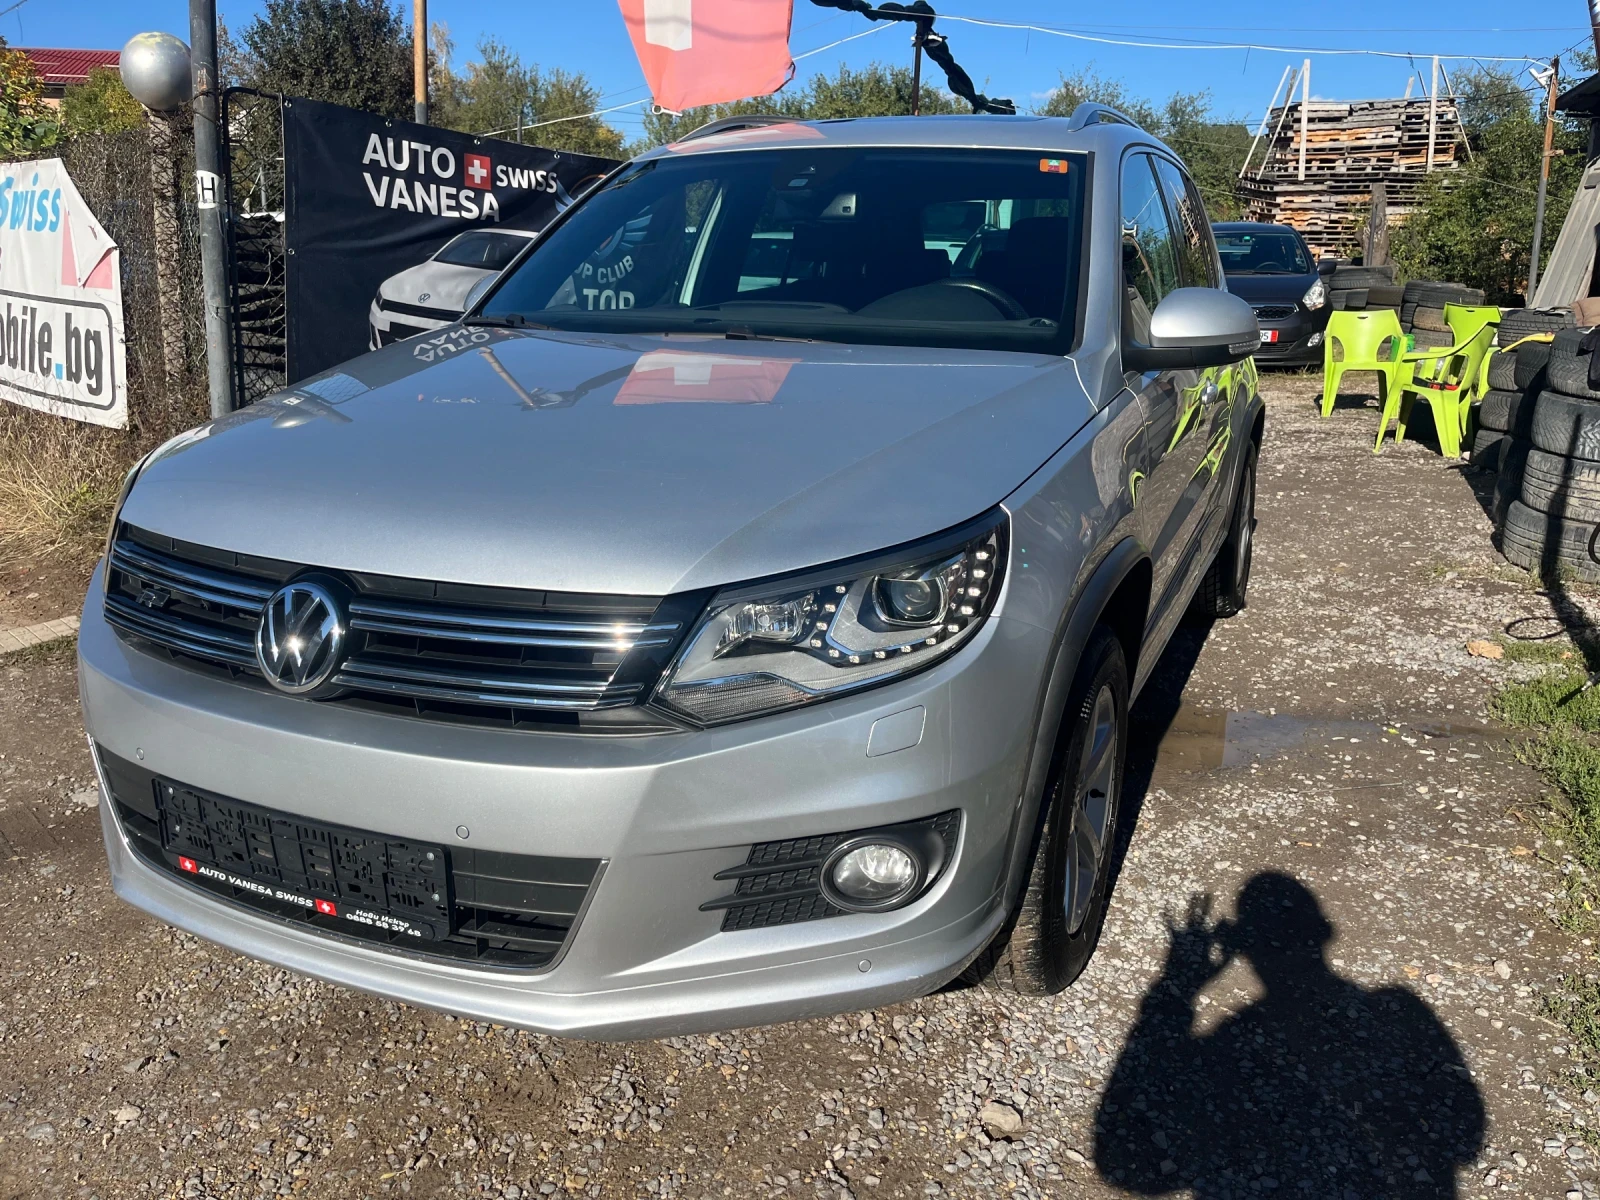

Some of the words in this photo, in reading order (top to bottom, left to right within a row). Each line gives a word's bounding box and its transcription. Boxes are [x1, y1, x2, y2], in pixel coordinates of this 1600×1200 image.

[362, 133, 456, 179] AUTO
[496, 165, 557, 193] SWISS
[198, 176, 215, 203] H
[362, 172, 500, 222] VANESA
[597, 255, 634, 284] CLUB
[199, 867, 226, 881] AUTO
[228, 875, 273, 896] VANESA
[275, 891, 314, 907] SWISS
